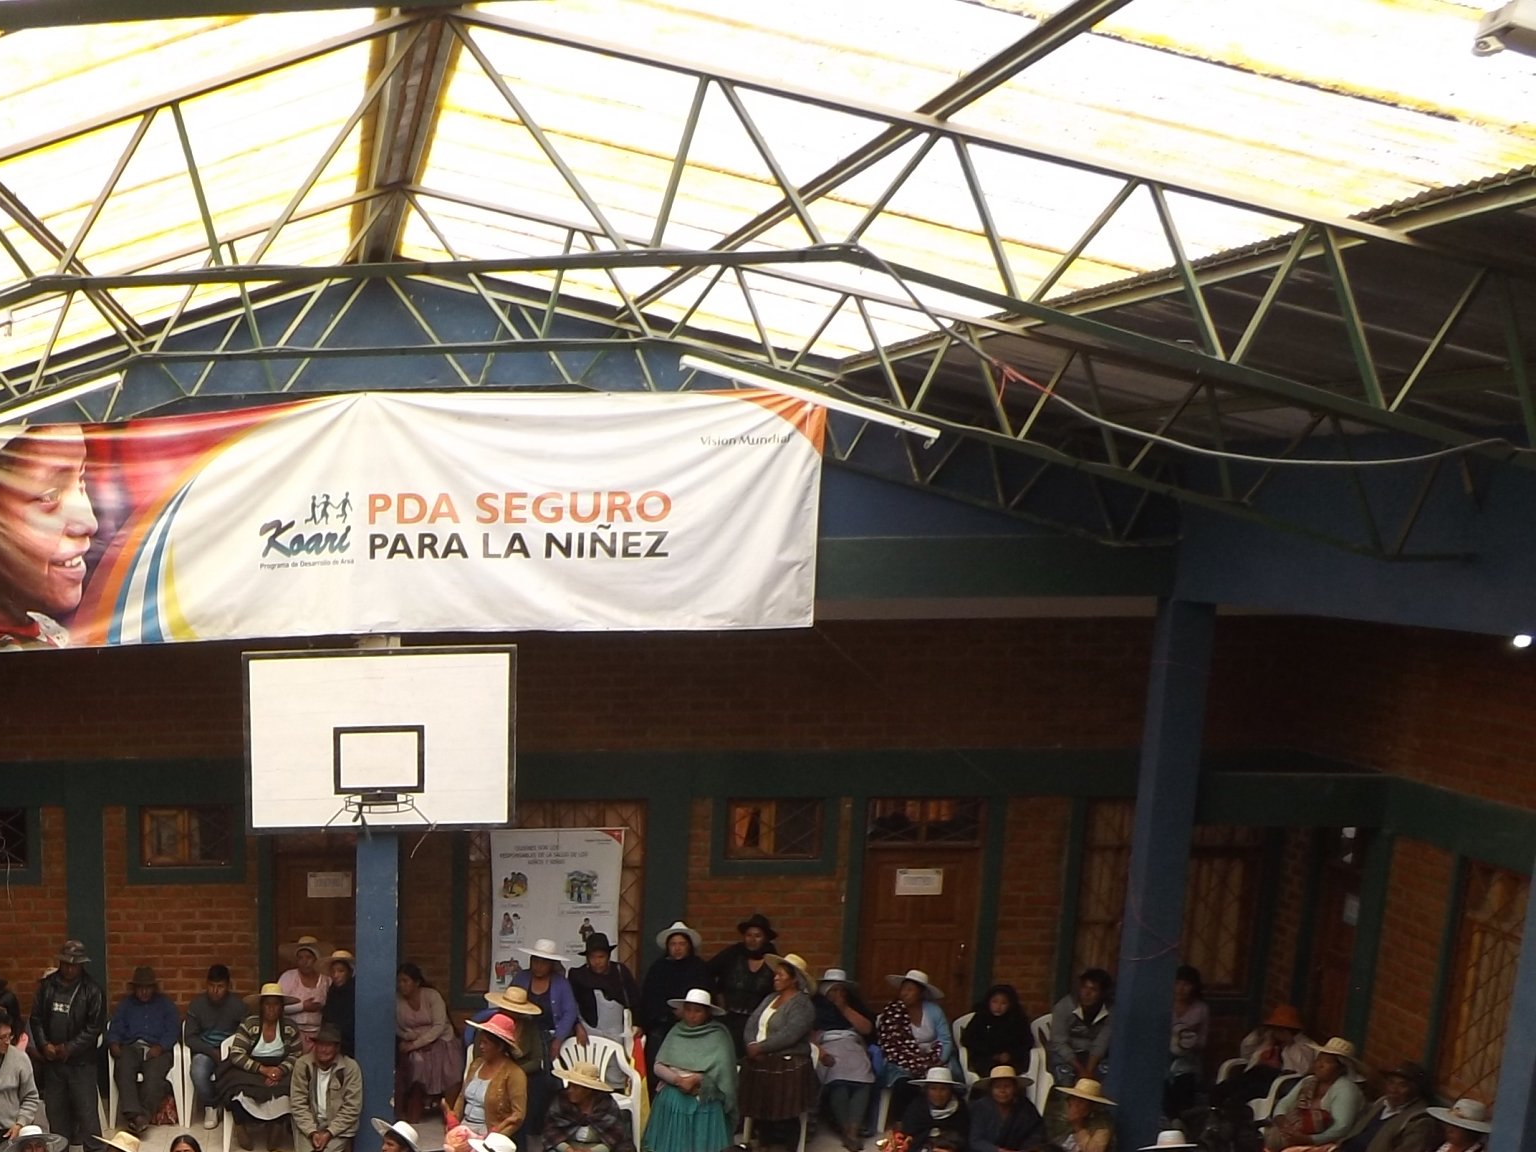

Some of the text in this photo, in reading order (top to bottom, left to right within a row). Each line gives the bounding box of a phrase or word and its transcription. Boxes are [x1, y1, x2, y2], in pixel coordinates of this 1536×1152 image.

[739, 433, 792, 446] Mundial
[368, 490, 672, 525] PDA SEGURO
[369, 522, 670, 560] PARA LA NIÑEZ
[260, 562, 290, 570] Programa
[300, 560, 331, 568] Desarrollo
